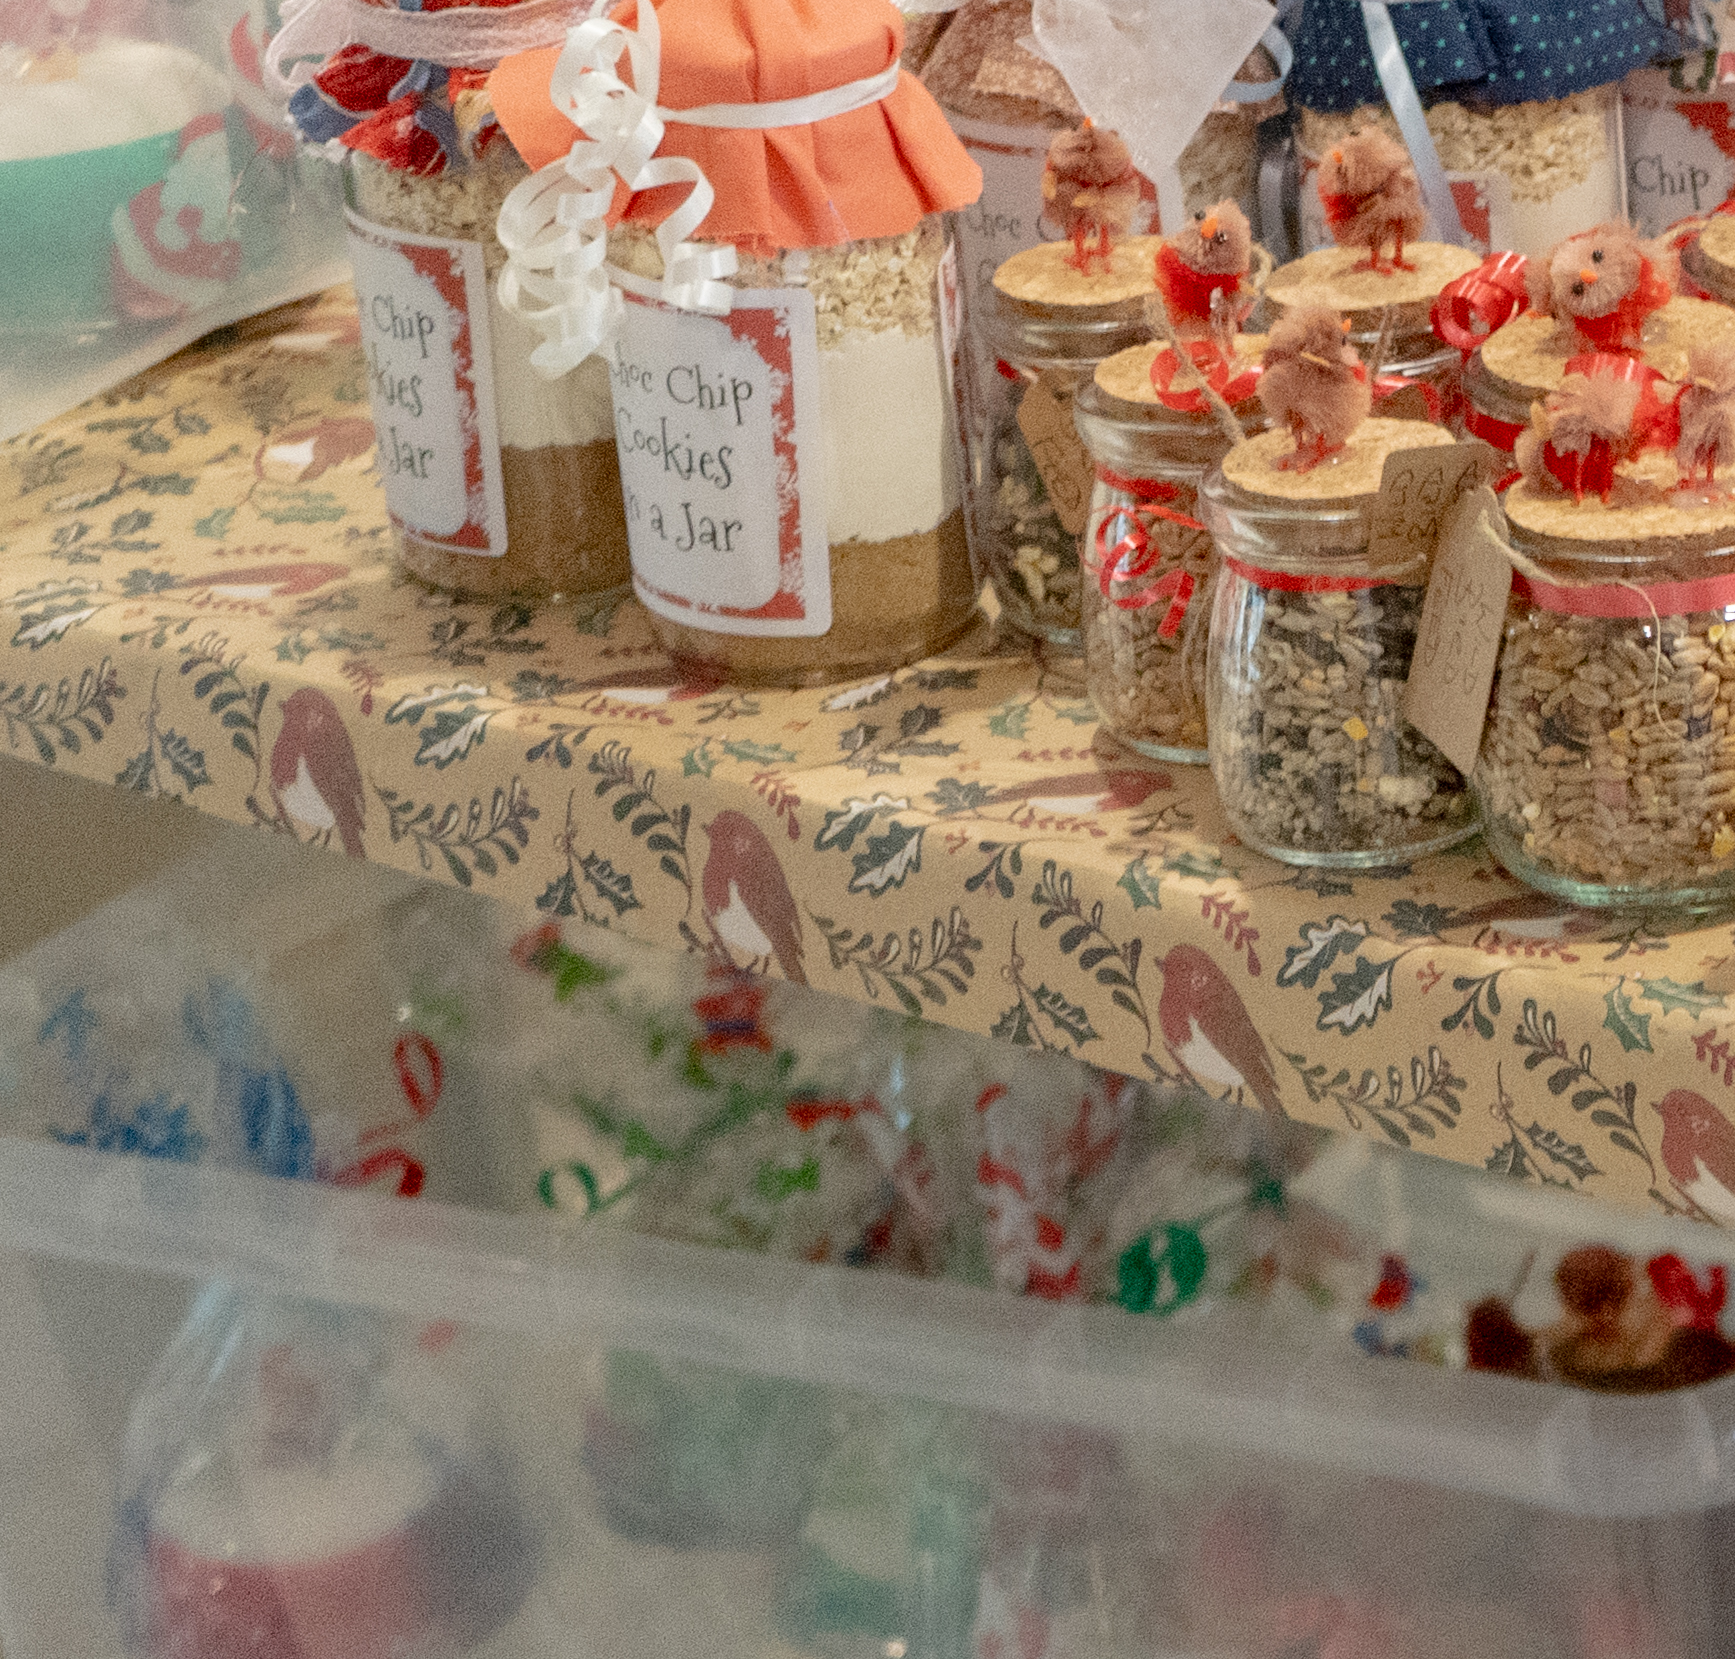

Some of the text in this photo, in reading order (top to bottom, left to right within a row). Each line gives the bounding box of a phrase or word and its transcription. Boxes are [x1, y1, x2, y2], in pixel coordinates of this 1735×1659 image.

[1630, 154, 1709, 210] Chip
[373, 294, 434, 360] Chip
[666, 364, 752, 425] Chip
[616, 407, 732, 489] Cookies
[650, 503, 667, 539] a
[673, 502, 742, 552] Jar
